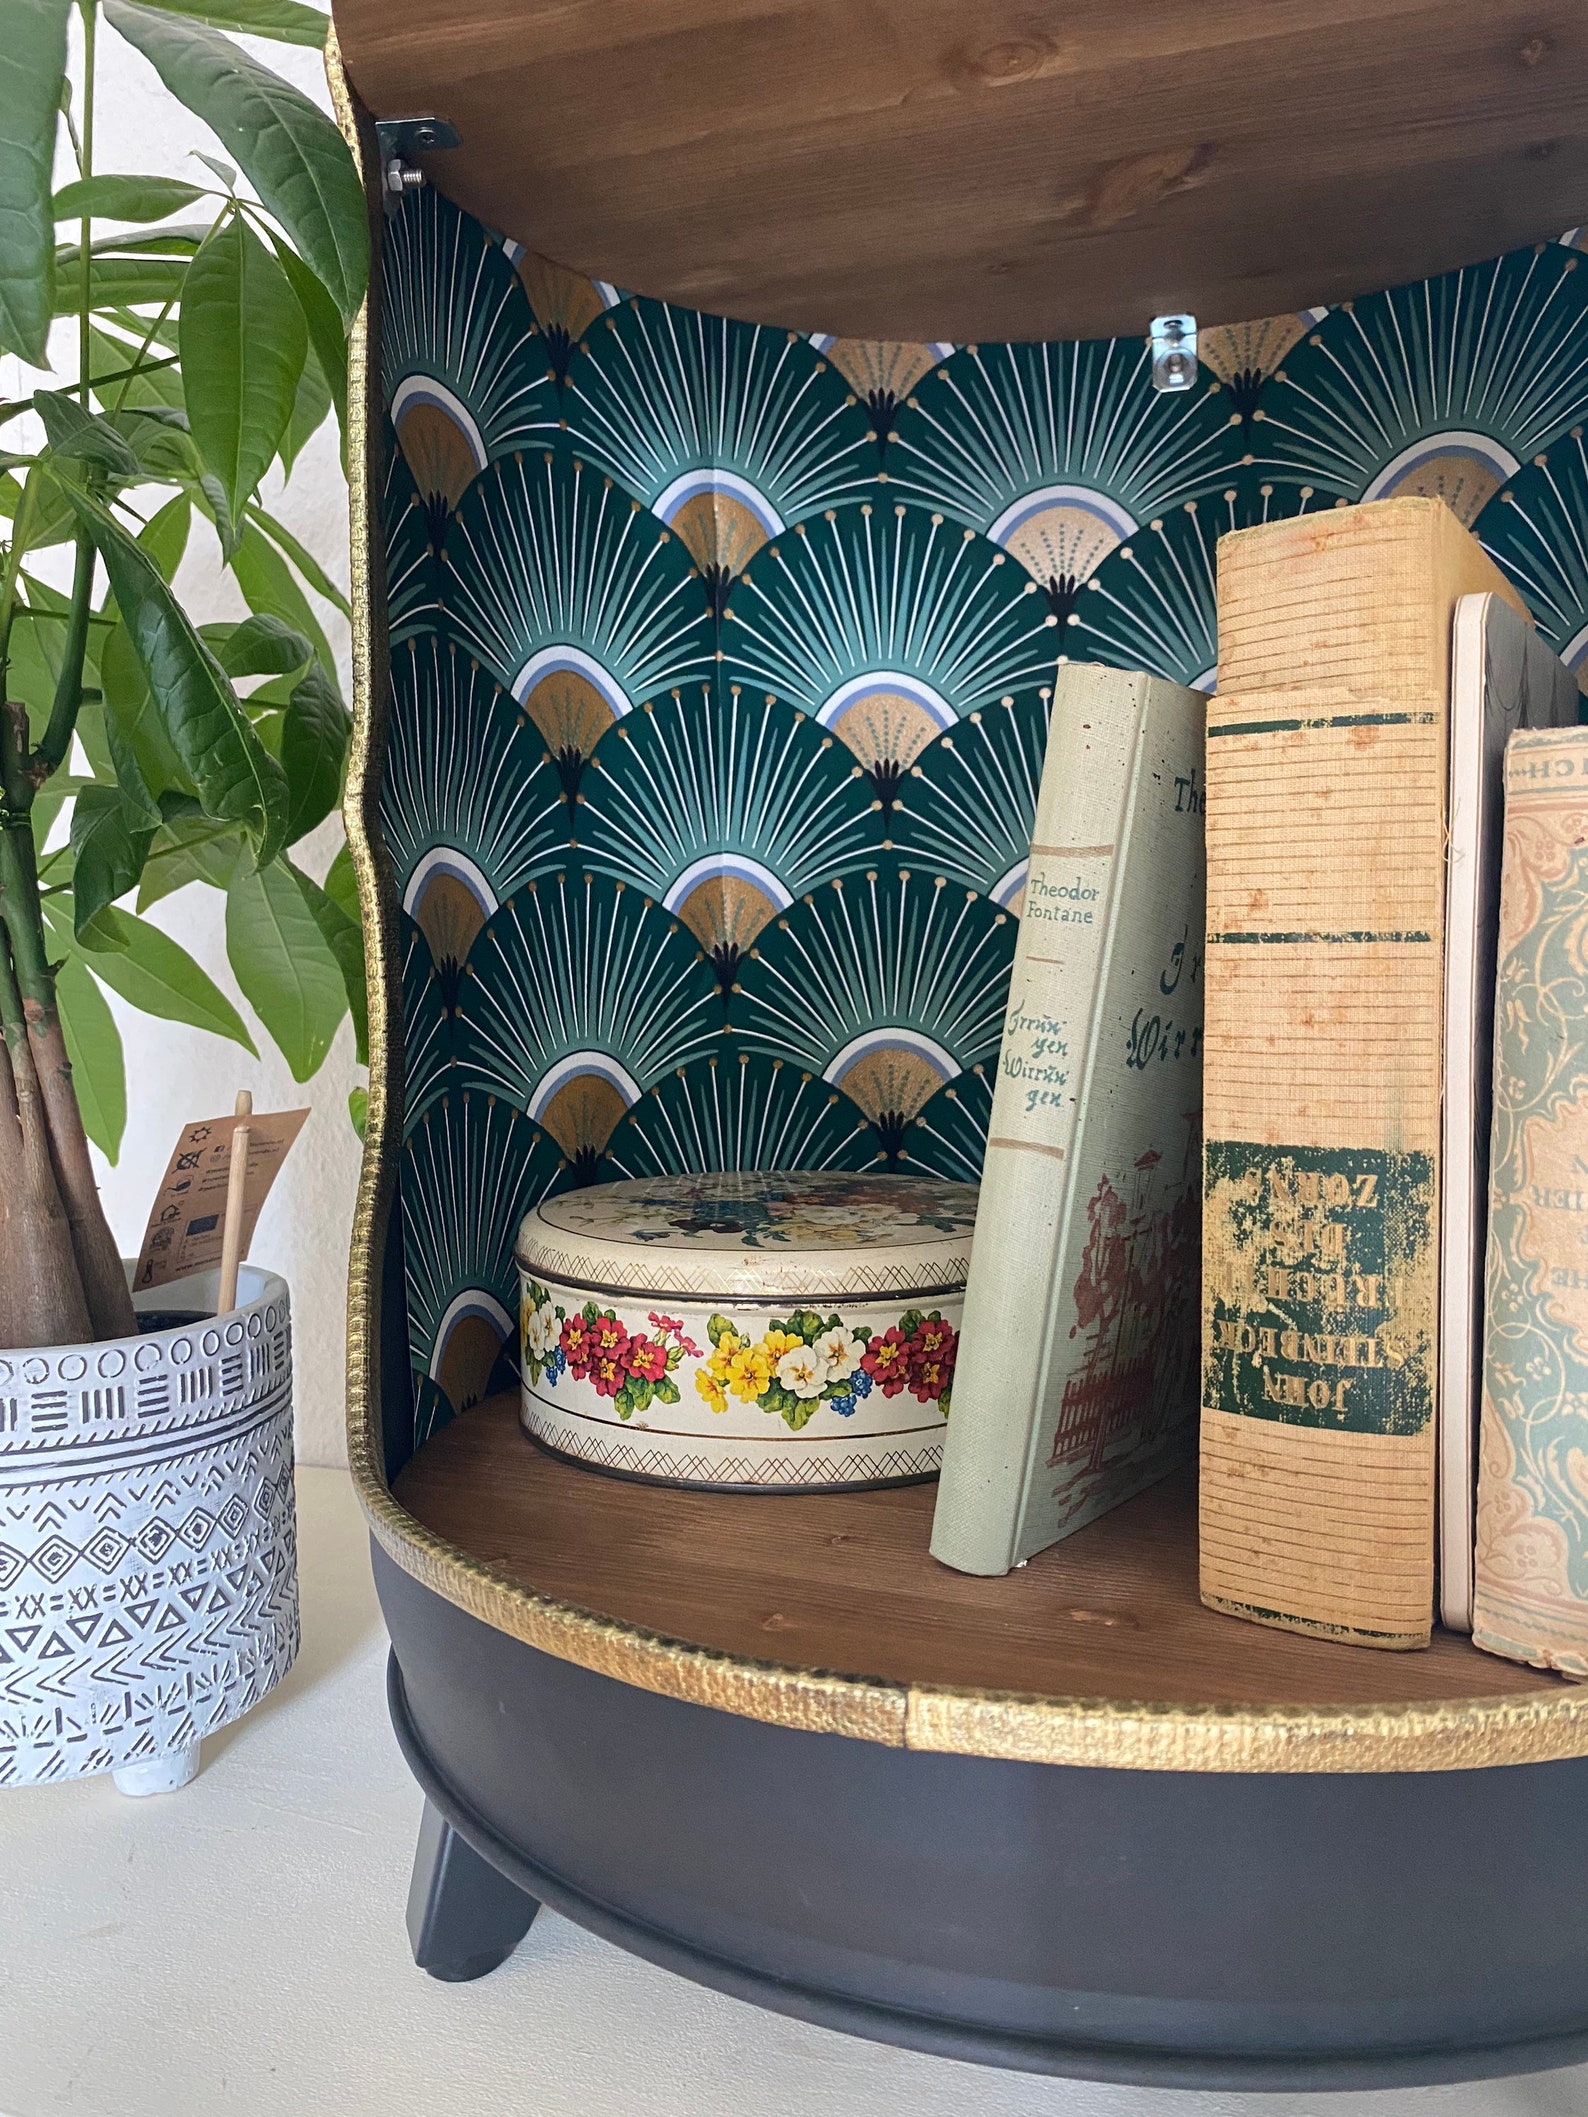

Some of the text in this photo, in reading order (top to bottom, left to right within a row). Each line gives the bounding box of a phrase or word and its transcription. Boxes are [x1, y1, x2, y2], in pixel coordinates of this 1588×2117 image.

[1030, 872, 1100, 901] Theodor
[1026, 901, 1093, 924] Fontane
[1244, 1166, 1379, 1208] ZORNS
[1216, 1320, 1406, 1368] STEINBECK
[1262, 1366, 1353, 1412] JOHN
